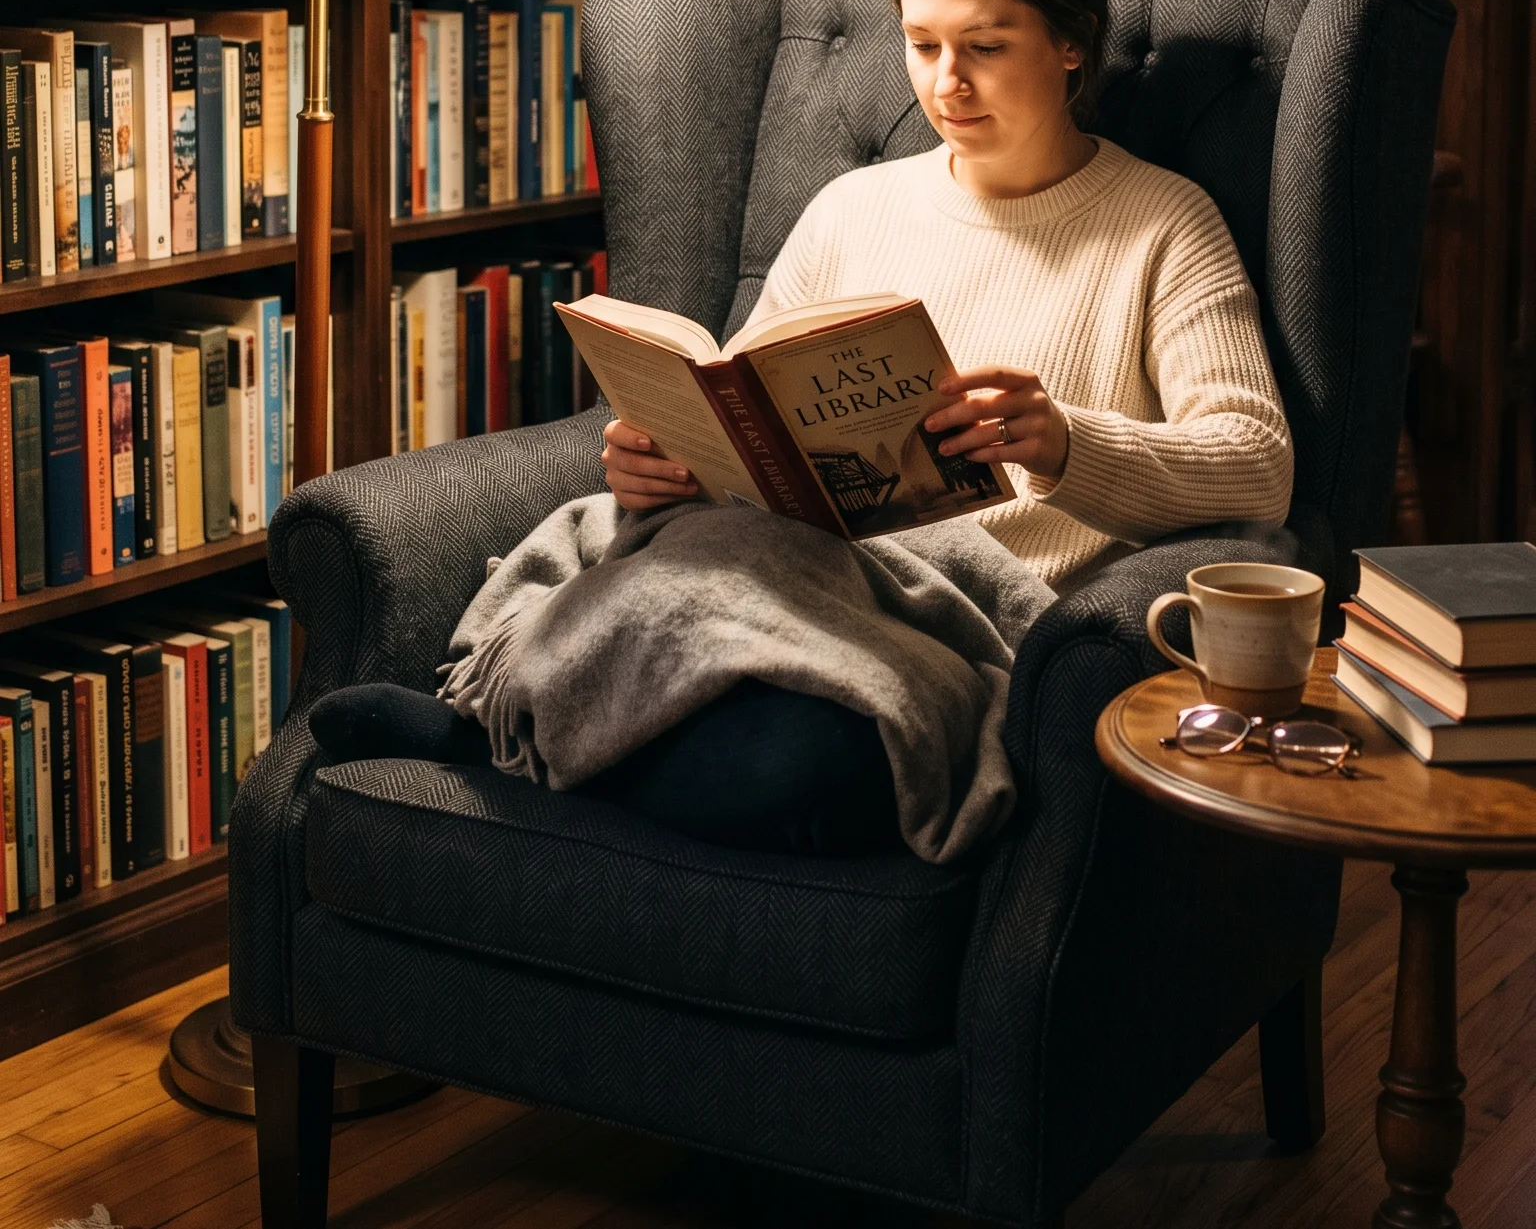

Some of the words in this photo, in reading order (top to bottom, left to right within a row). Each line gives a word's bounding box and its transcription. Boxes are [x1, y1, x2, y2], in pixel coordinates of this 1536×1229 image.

[827, 346, 865, 364] THE
[810, 354, 893, 395] LAST
[718, 386, 749, 418] THE
[794, 369, 935, 427] LIBRARY
